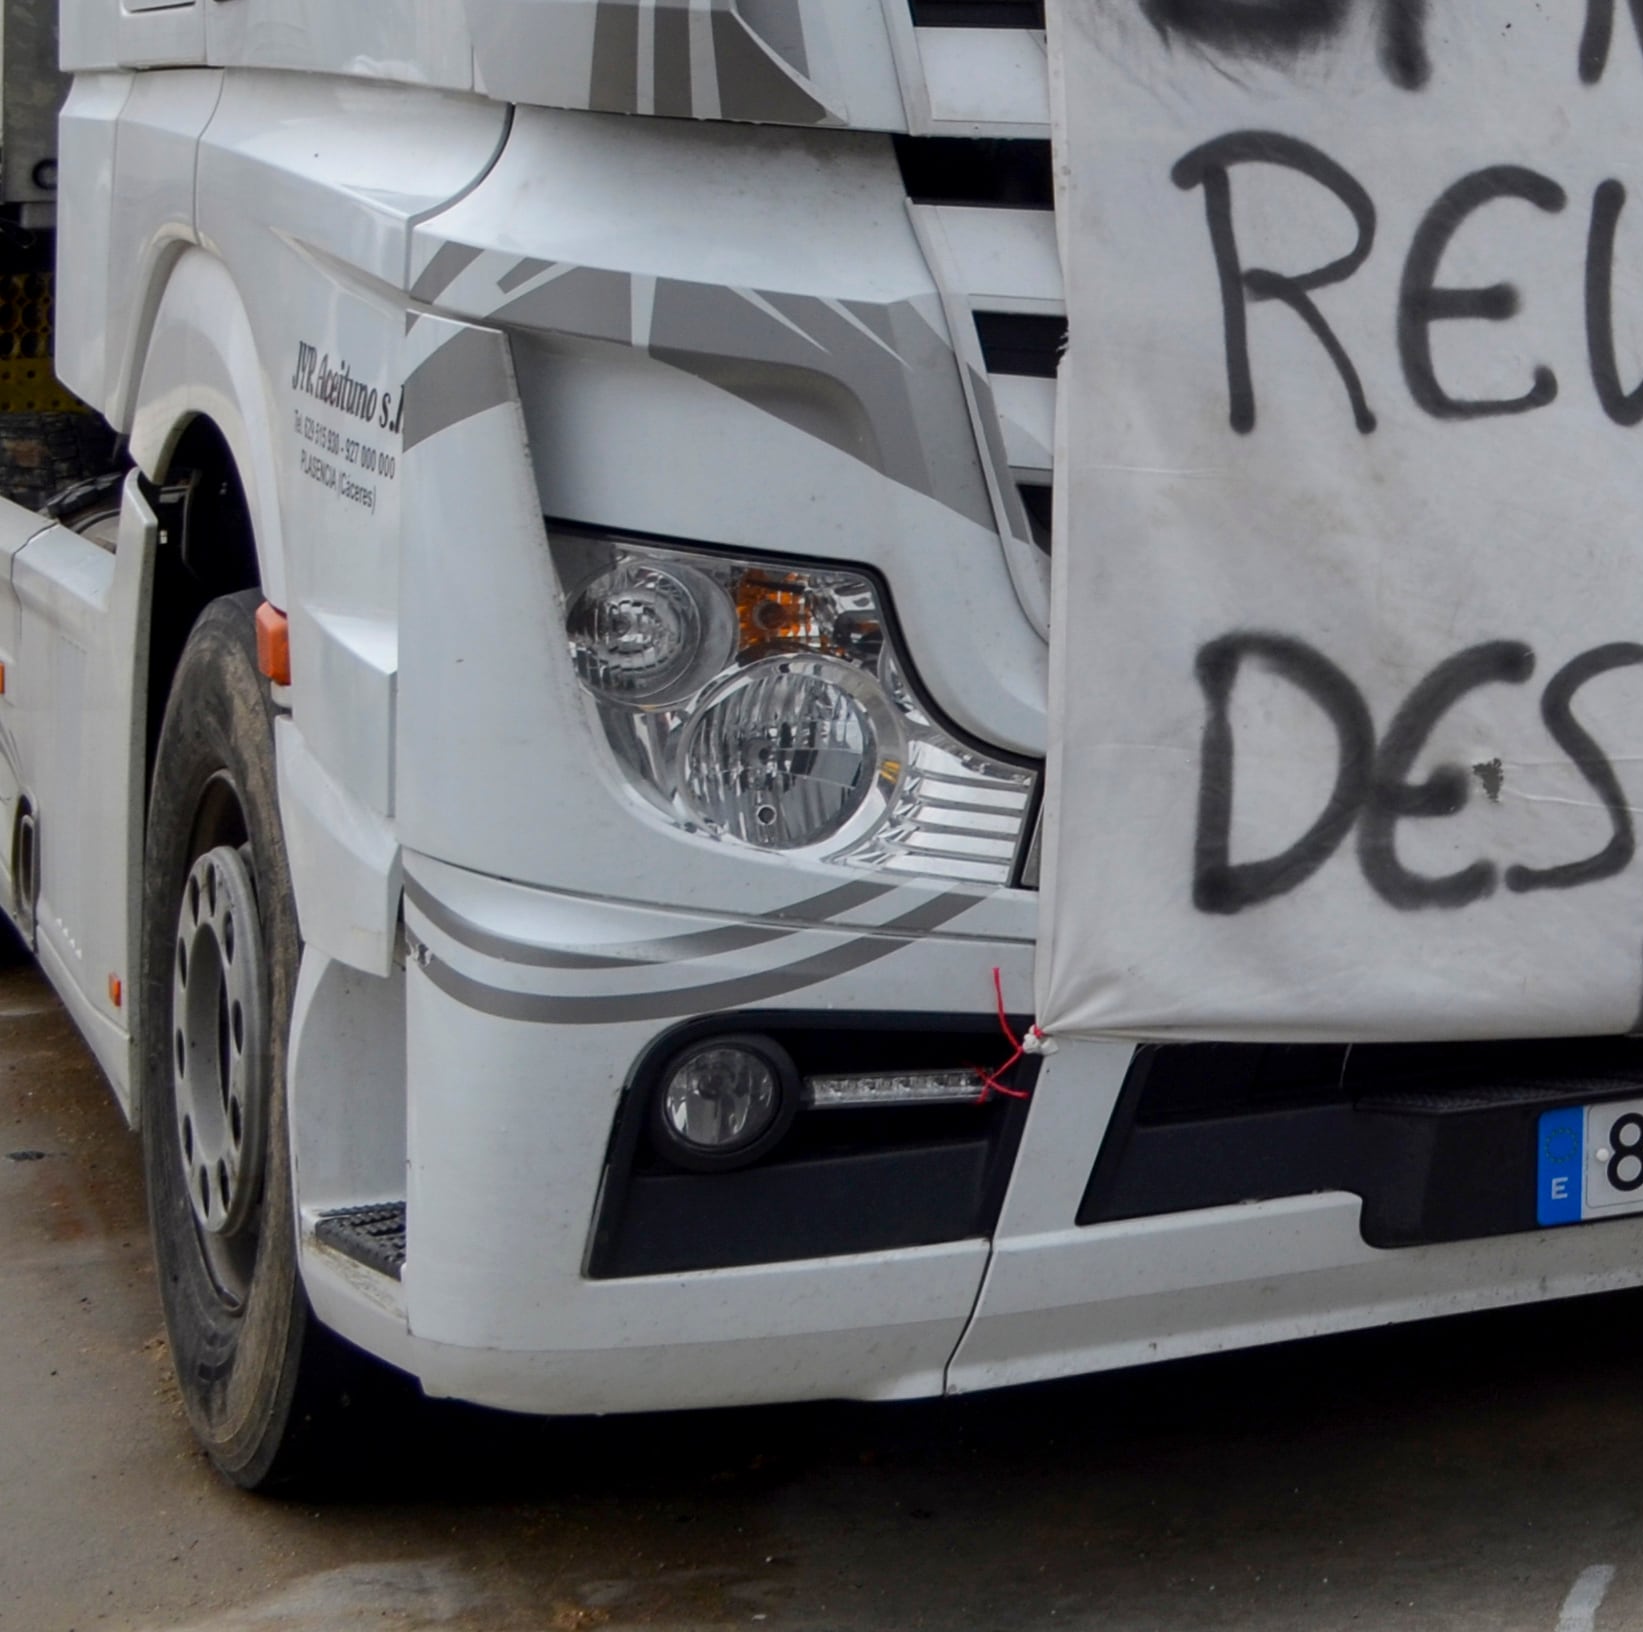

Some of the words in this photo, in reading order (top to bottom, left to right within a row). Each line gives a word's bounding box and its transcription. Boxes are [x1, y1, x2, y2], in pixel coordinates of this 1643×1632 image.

[314, 353, 378, 424] Aceituno
[360, 445, 377, 472] 000
[378, 452, 396, 480] 000
[1551, 1177, 1568, 1200] E
